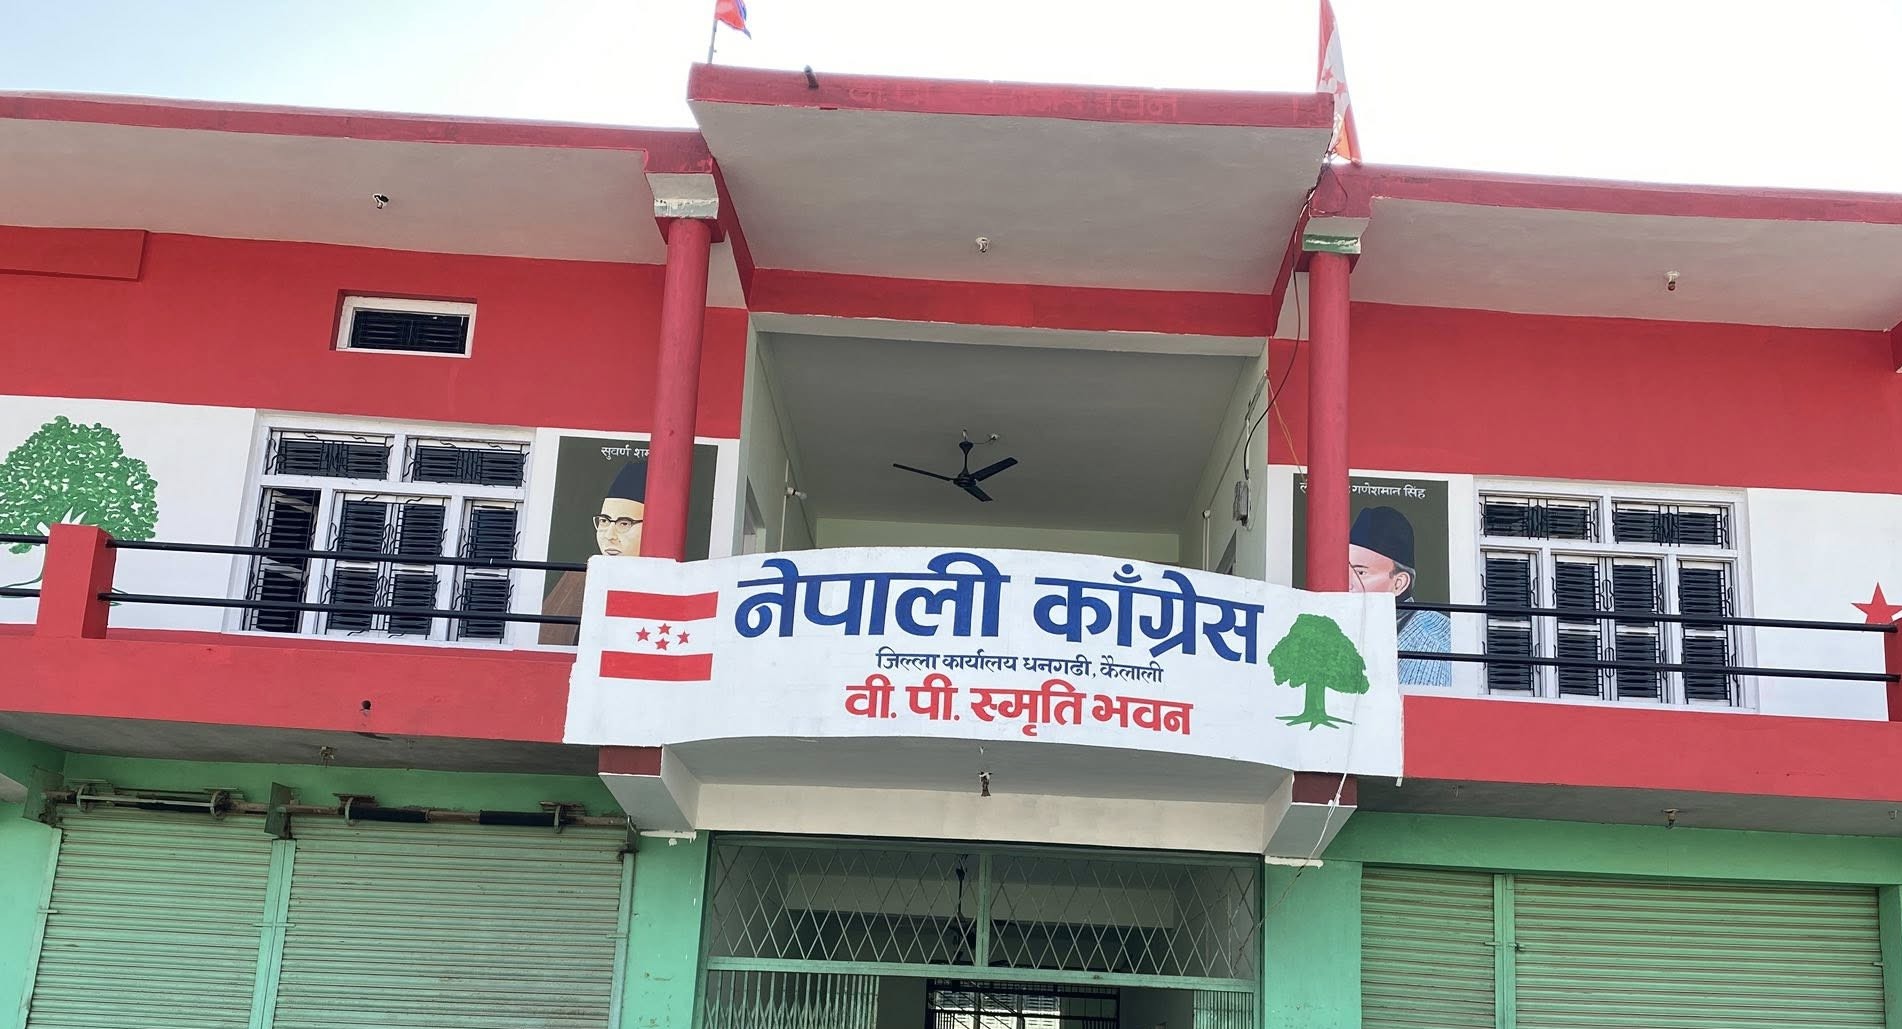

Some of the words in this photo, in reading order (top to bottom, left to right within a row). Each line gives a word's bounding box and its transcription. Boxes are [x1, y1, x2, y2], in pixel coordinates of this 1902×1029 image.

[602, 444, 632, 460] सुवर्ण
[1352, 481, 1402, 496] गणेशमान
[1403, 483, 1427, 499] सिंह
[735, 552, 1012, 638] नेपाली
[1033, 564, 1265, 665] काँग्रेस
[875, 646, 941, 670] जिल्ला
[942, 648, 1018, 672] कार्यालय
[1100, 655, 1164, 683] कैलाली
[845, 674, 898, 718] वी.
[906, 674, 961, 720] पी.
[971, 678, 1087, 736] स्मृति
[1092, 694, 1194, 735] भवन
